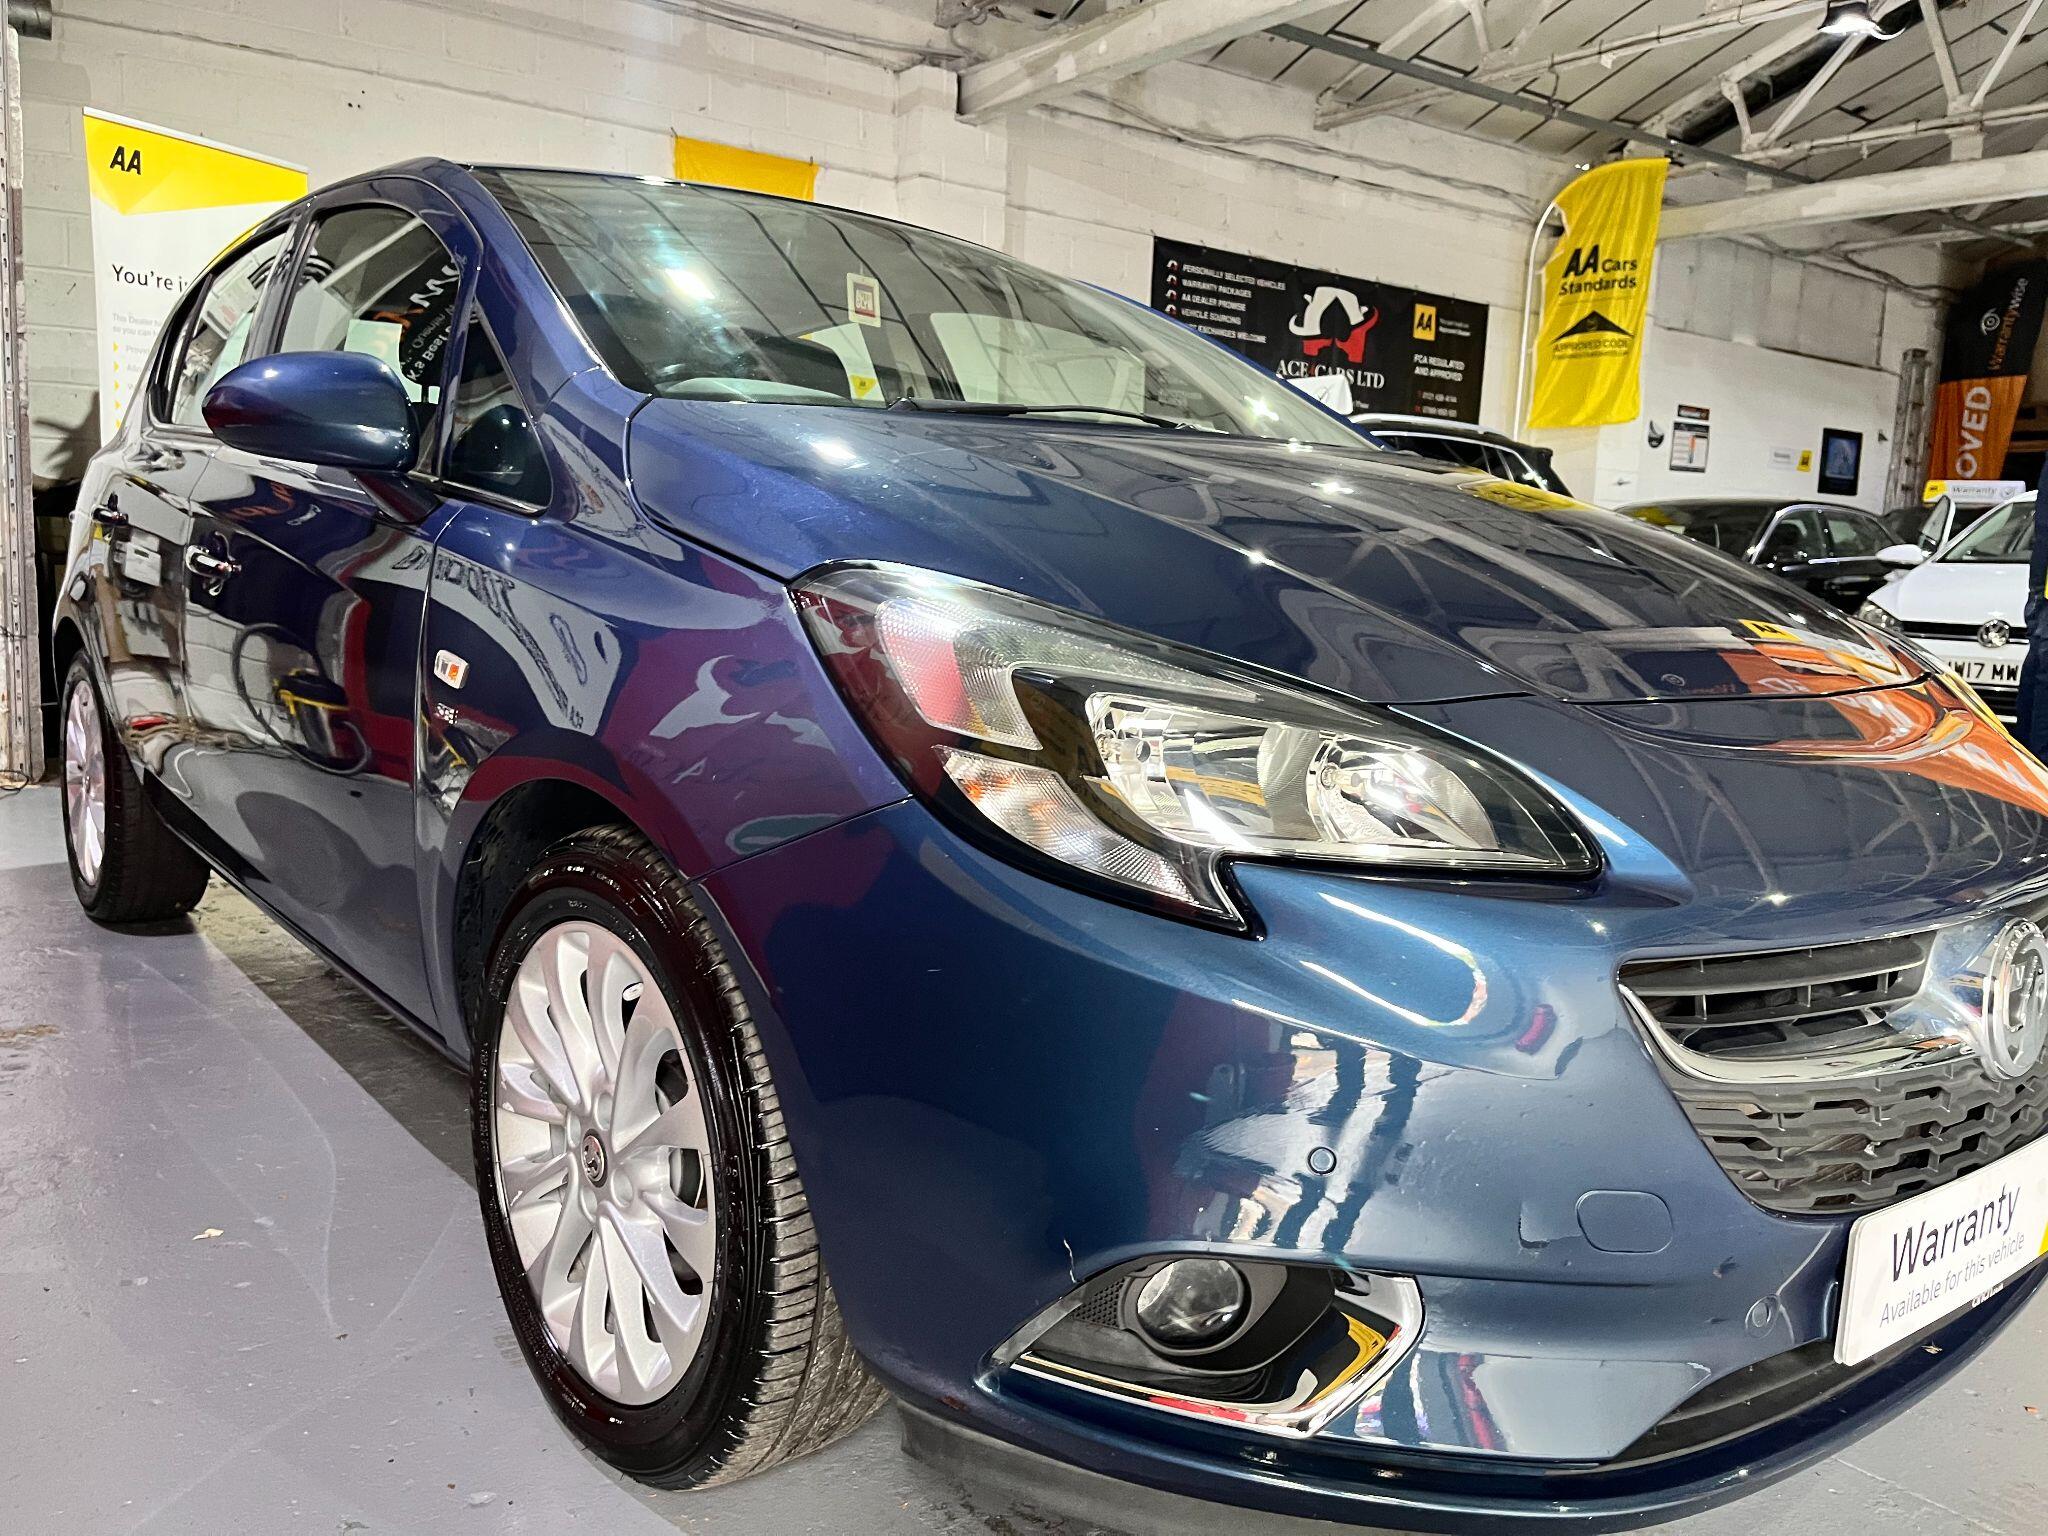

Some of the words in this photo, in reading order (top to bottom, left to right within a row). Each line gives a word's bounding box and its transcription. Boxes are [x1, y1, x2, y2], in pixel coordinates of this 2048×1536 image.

[109, 145, 142, 176] AA
[1561, 244, 1600, 278] AA
[1601, 258, 1638, 273] Cars
[112, 263, 173, 291] You're
[1181, 279, 1217, 292] WARRANTY
[1218, 285, 1252, 298] PACKAGES
[1182, 264, 1224, 279] PERSONALLY
[1224, 271, 1256, 285] SELECTED
[1256, 278, 1287, 291] VEHICLES
[1558, 275, 1637, 296] Standards
[1181, 293, 1191, 302] AA
[1191, 294, 1217, 306] DEALER
[1218, 299, 1247, 312] PROMISE
[1181, 307, 1209, 319] VEHICLE
[1209, 313, 1242, 325] SOURCING
[1416, 312, 1433, 331] AA
[1237, 331, 1267, 344] WELCOME
[1276, 359, 1308, 377] ACE
[1356, 370, 1385, 389] LTD
[1955, 386, 1992, 479] OVED
[1948, 661, 1985, 679] W17
[1991, 664, 2019, 681] MW
[1892, 1183, 2021, 1283] Warranty
[1879, 1280, 1942, 1329] Available
[1943, 1269, 1963, 1296] for
[1964, 1256, 1986, 1283] this
[1988, 1231, 2026, 1265] vehicle
